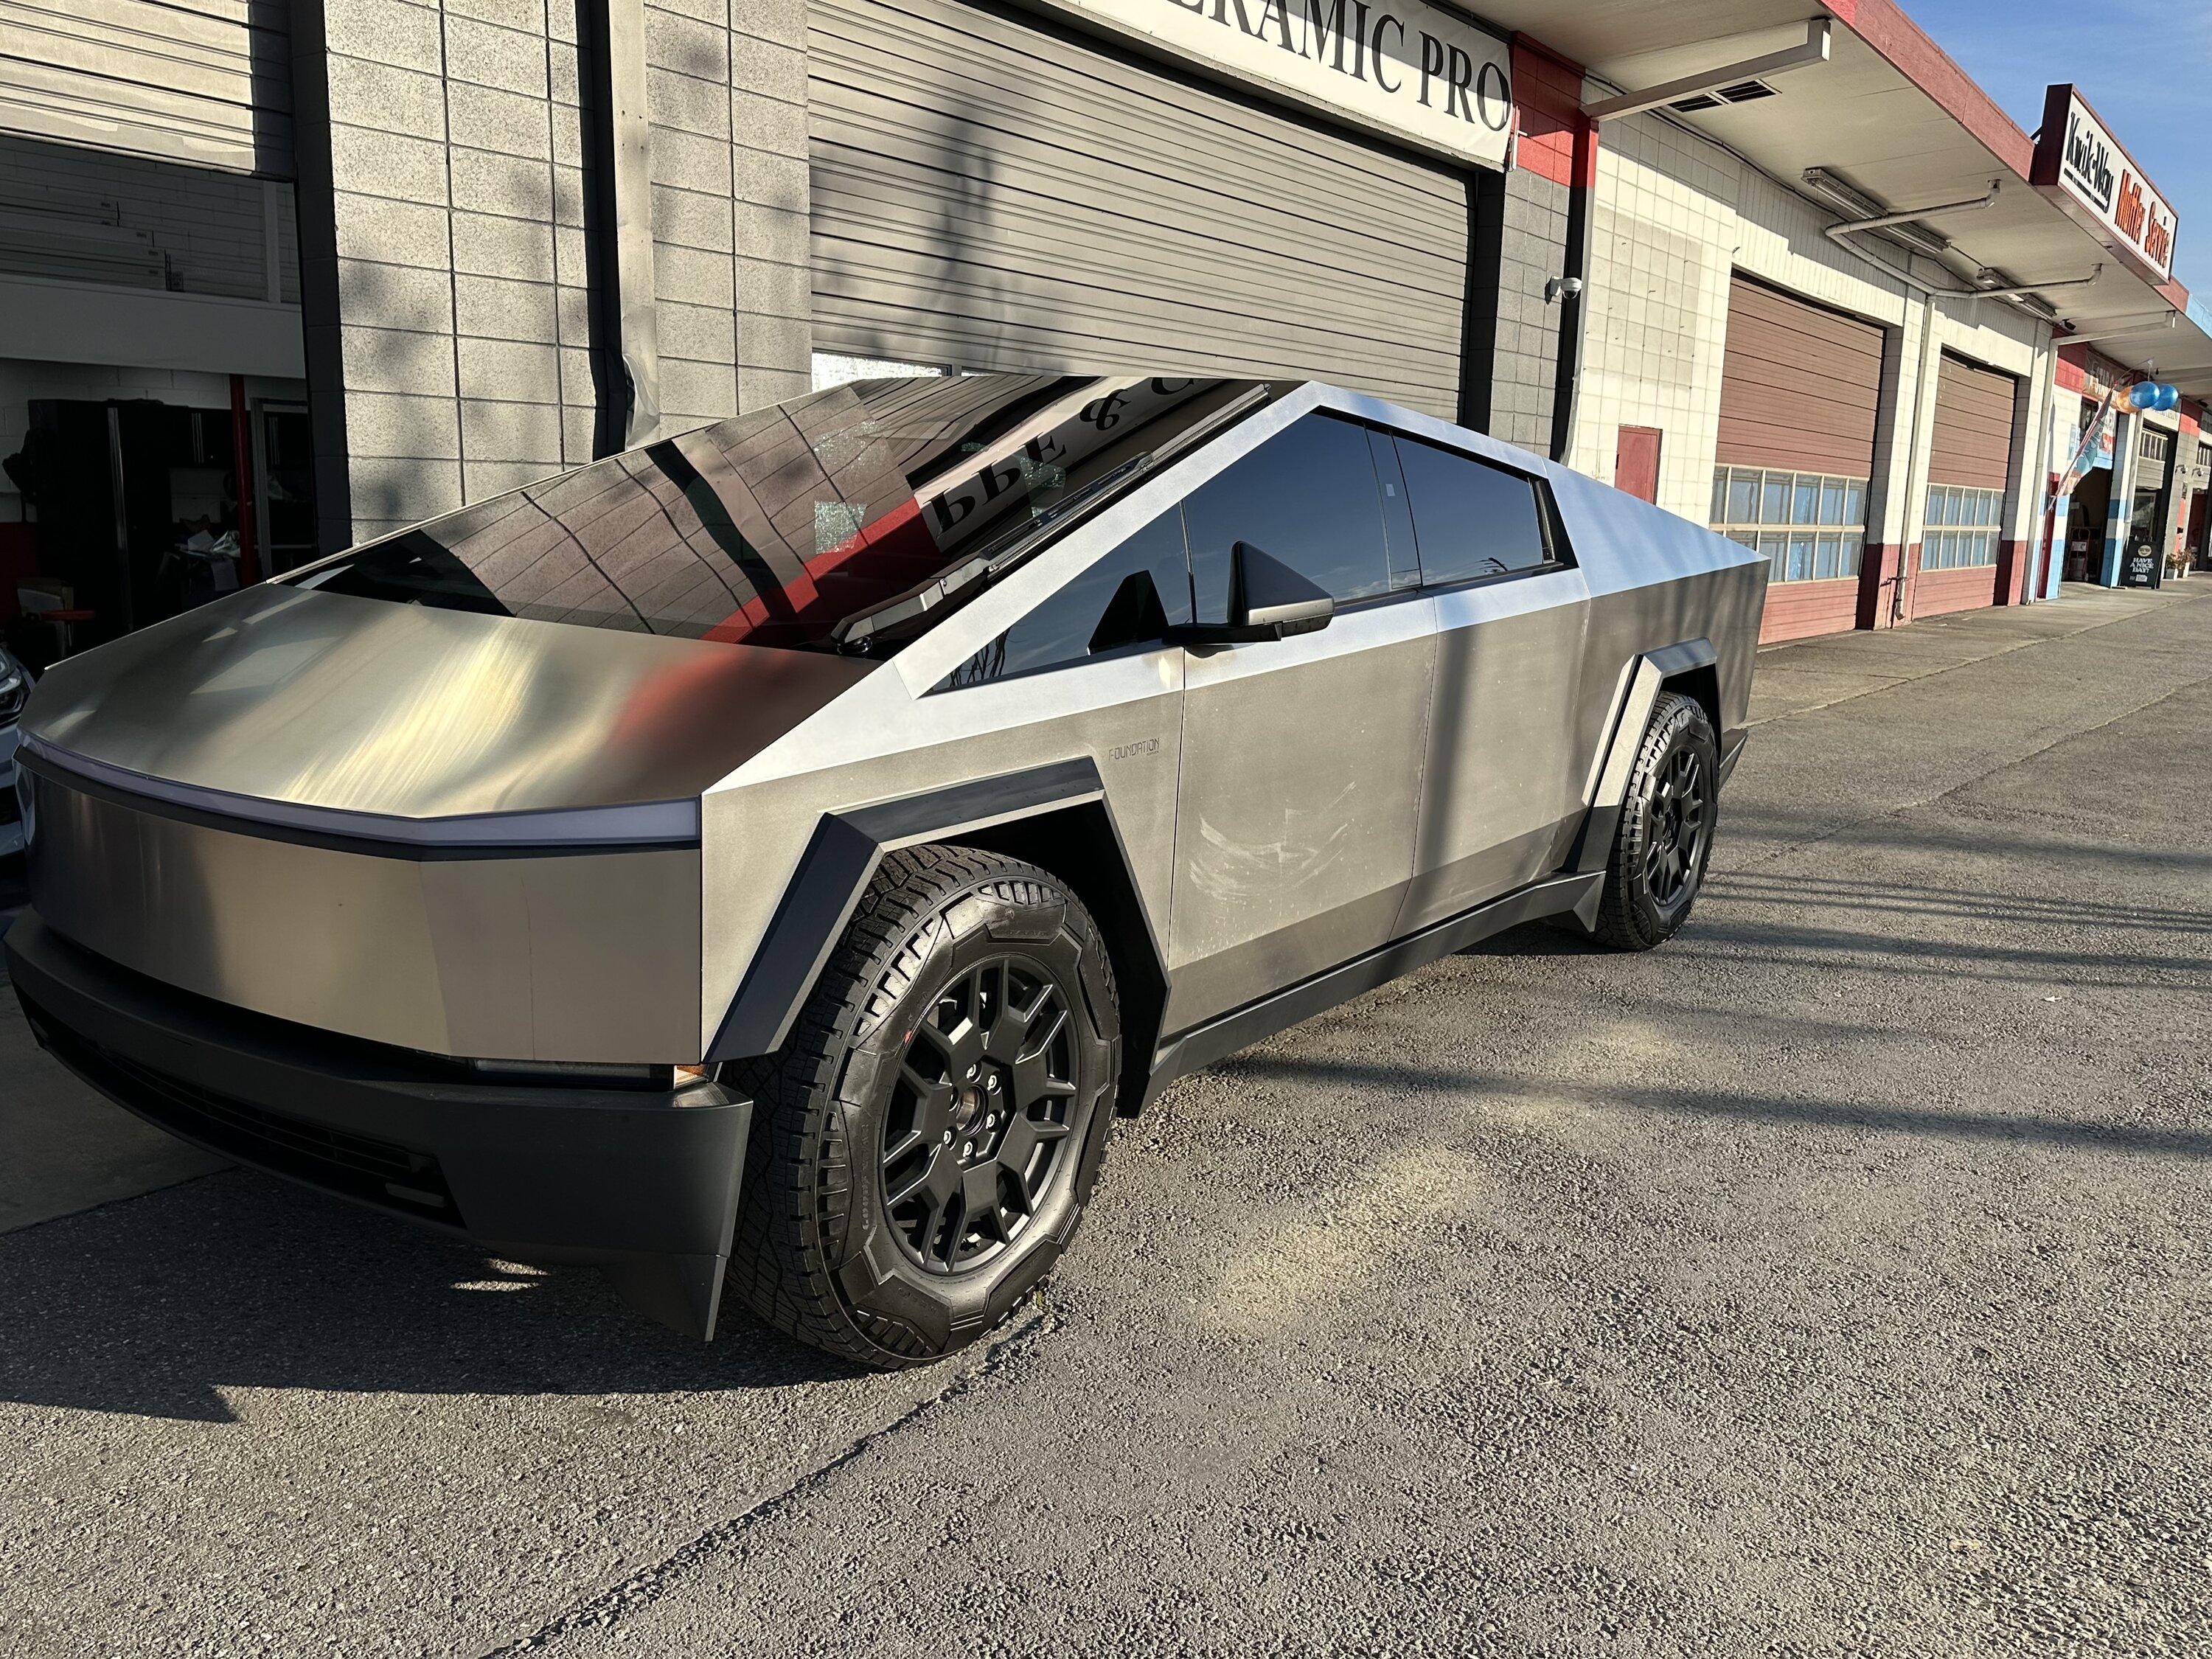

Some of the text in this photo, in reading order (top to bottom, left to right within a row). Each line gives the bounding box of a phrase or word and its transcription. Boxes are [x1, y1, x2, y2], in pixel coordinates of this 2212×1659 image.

[1166, 0, 1512, 132] AMIC PRO
[2065, 111, 2170, 269] Kwik-Way Muffler Service
[1108, 737, 1161, 762] FOUNDATION
